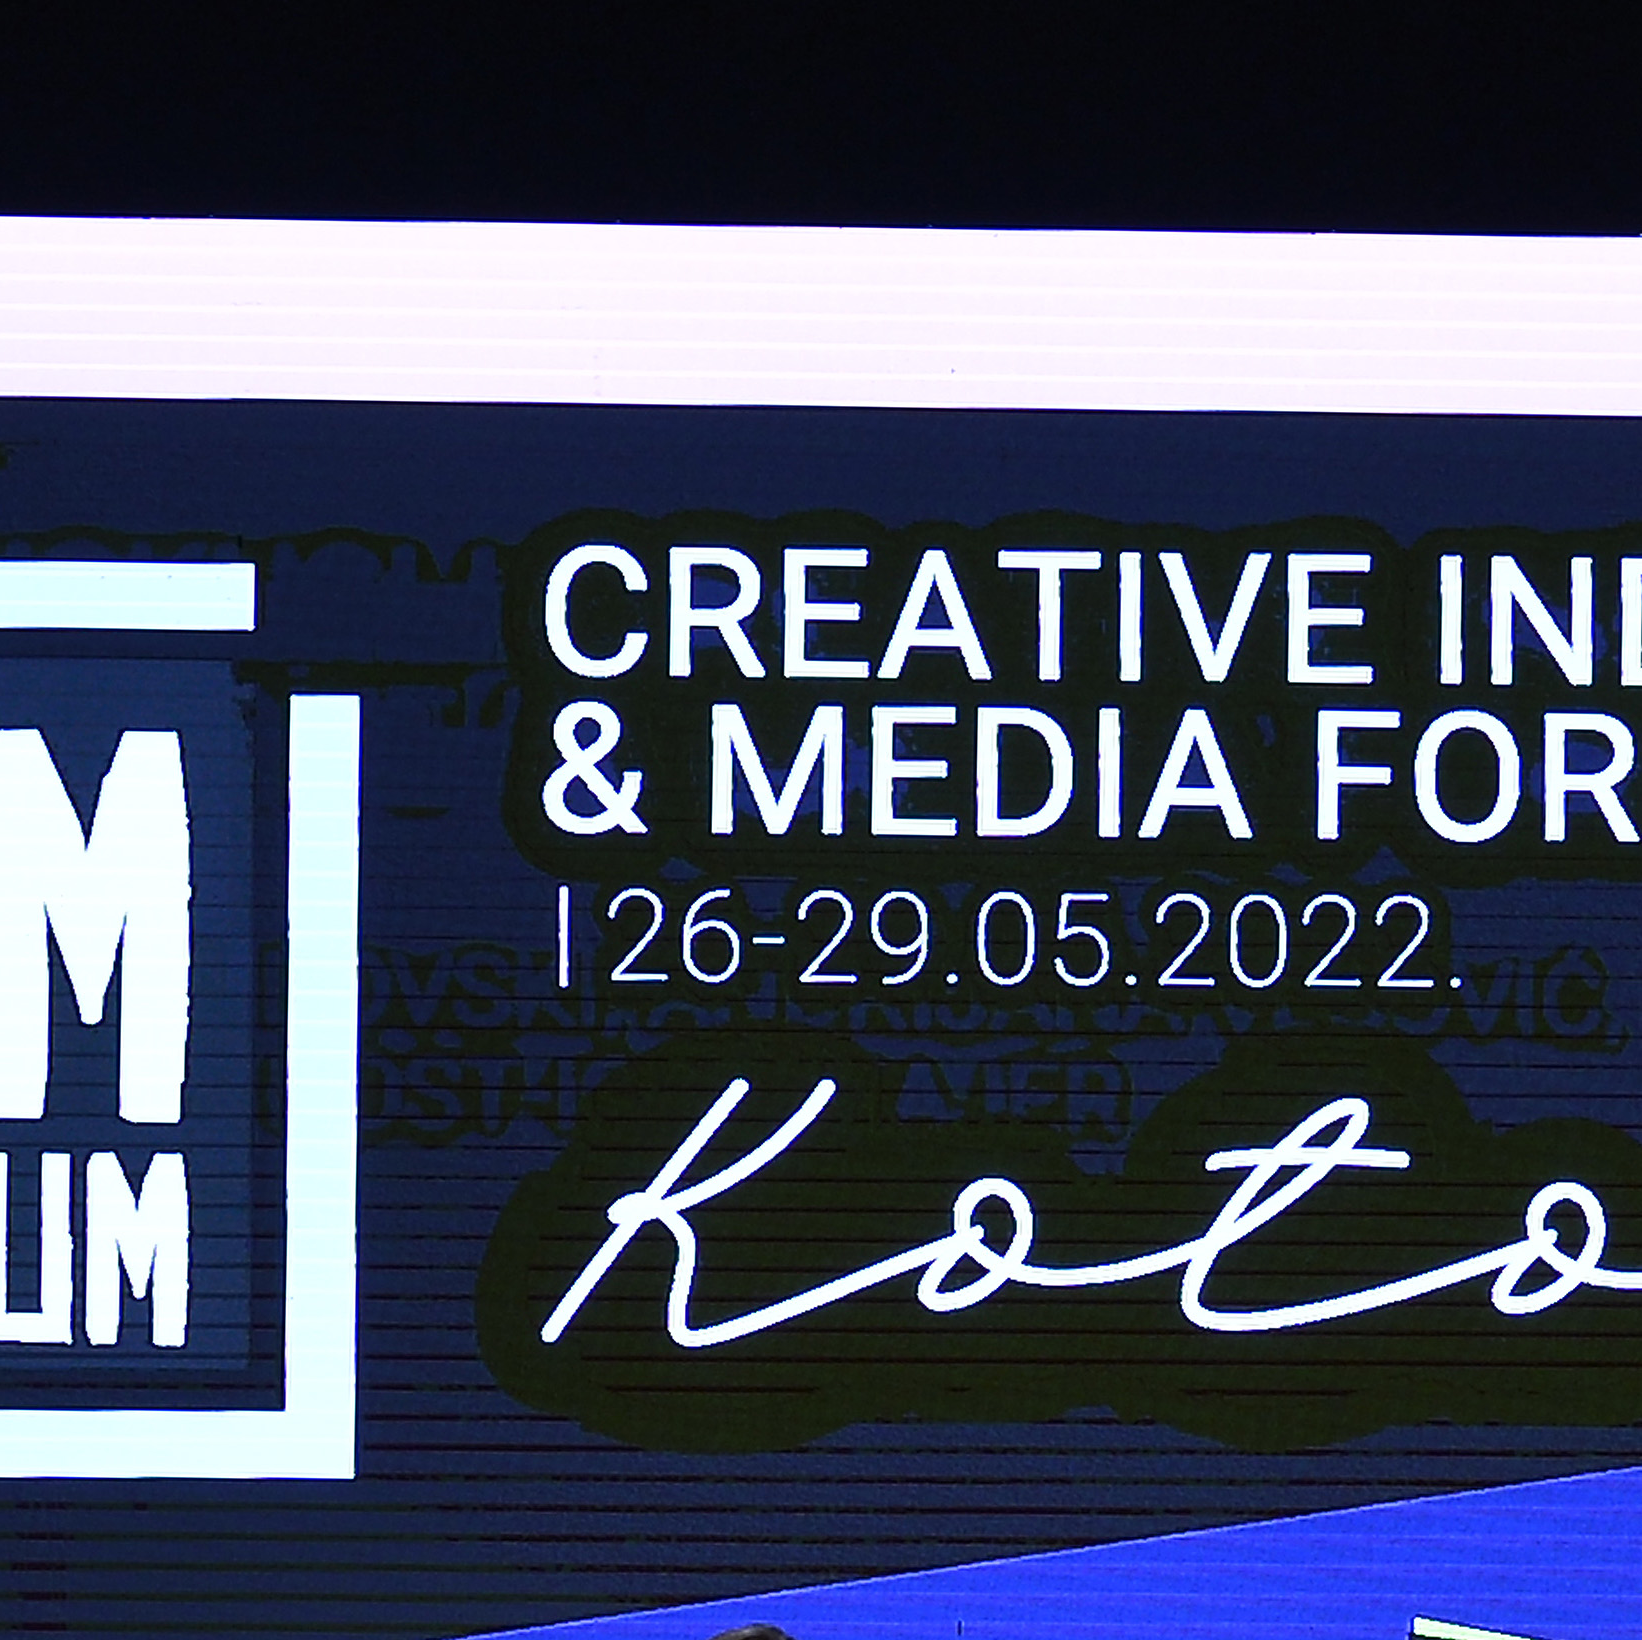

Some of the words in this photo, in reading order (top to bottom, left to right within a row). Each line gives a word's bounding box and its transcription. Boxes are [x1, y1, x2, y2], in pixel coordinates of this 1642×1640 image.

[546, 545, 1373, 684] CREATIVE
[543, 702, 648, 834] &
[712, 704, 1252, 839] MEDIA
